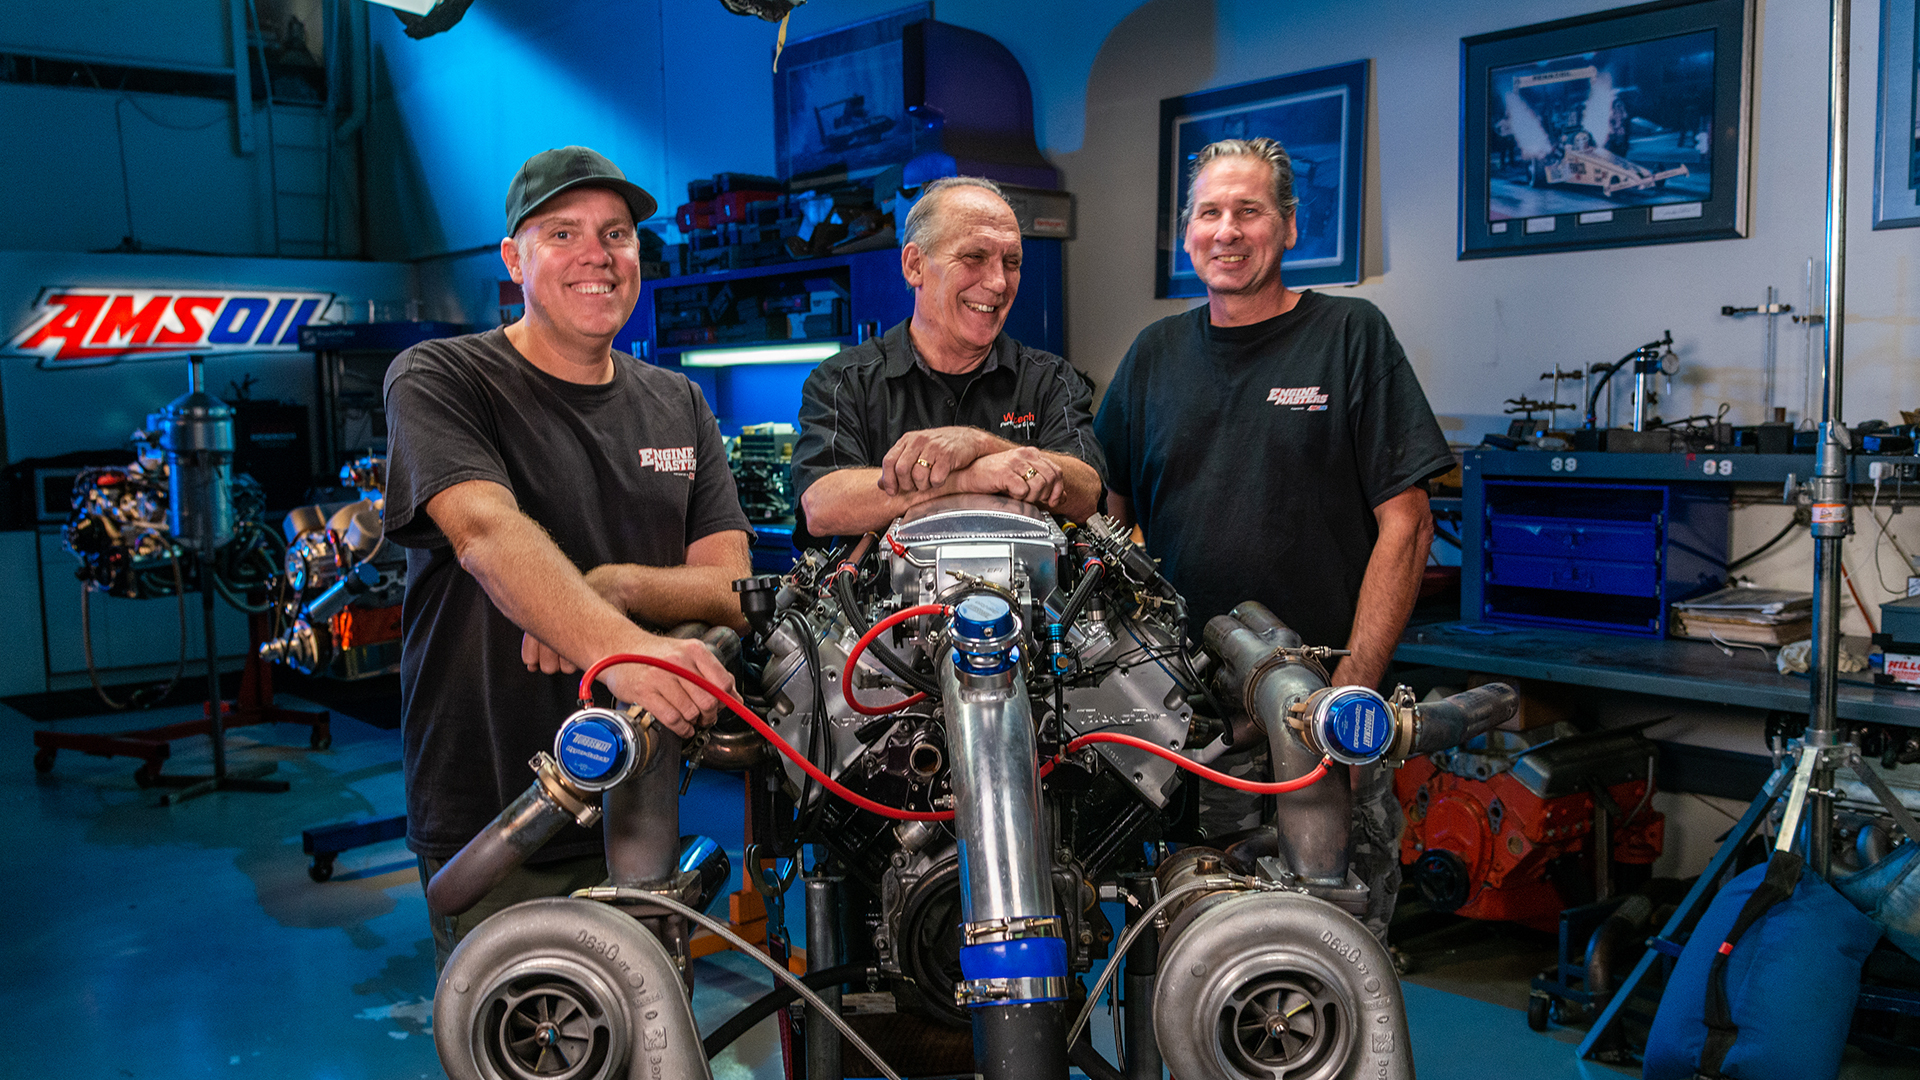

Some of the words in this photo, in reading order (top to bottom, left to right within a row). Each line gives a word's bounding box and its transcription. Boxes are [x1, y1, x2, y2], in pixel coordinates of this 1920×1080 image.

[18, 294, 326, 361] AMSOIL
[1266, 386, 1320, 401] ENGINE
[1274, 394, 1329, 405] MASTERS
[639, 447, 694, 467] ENGINE
[572, 731, 612, 753] TURBOSMART
